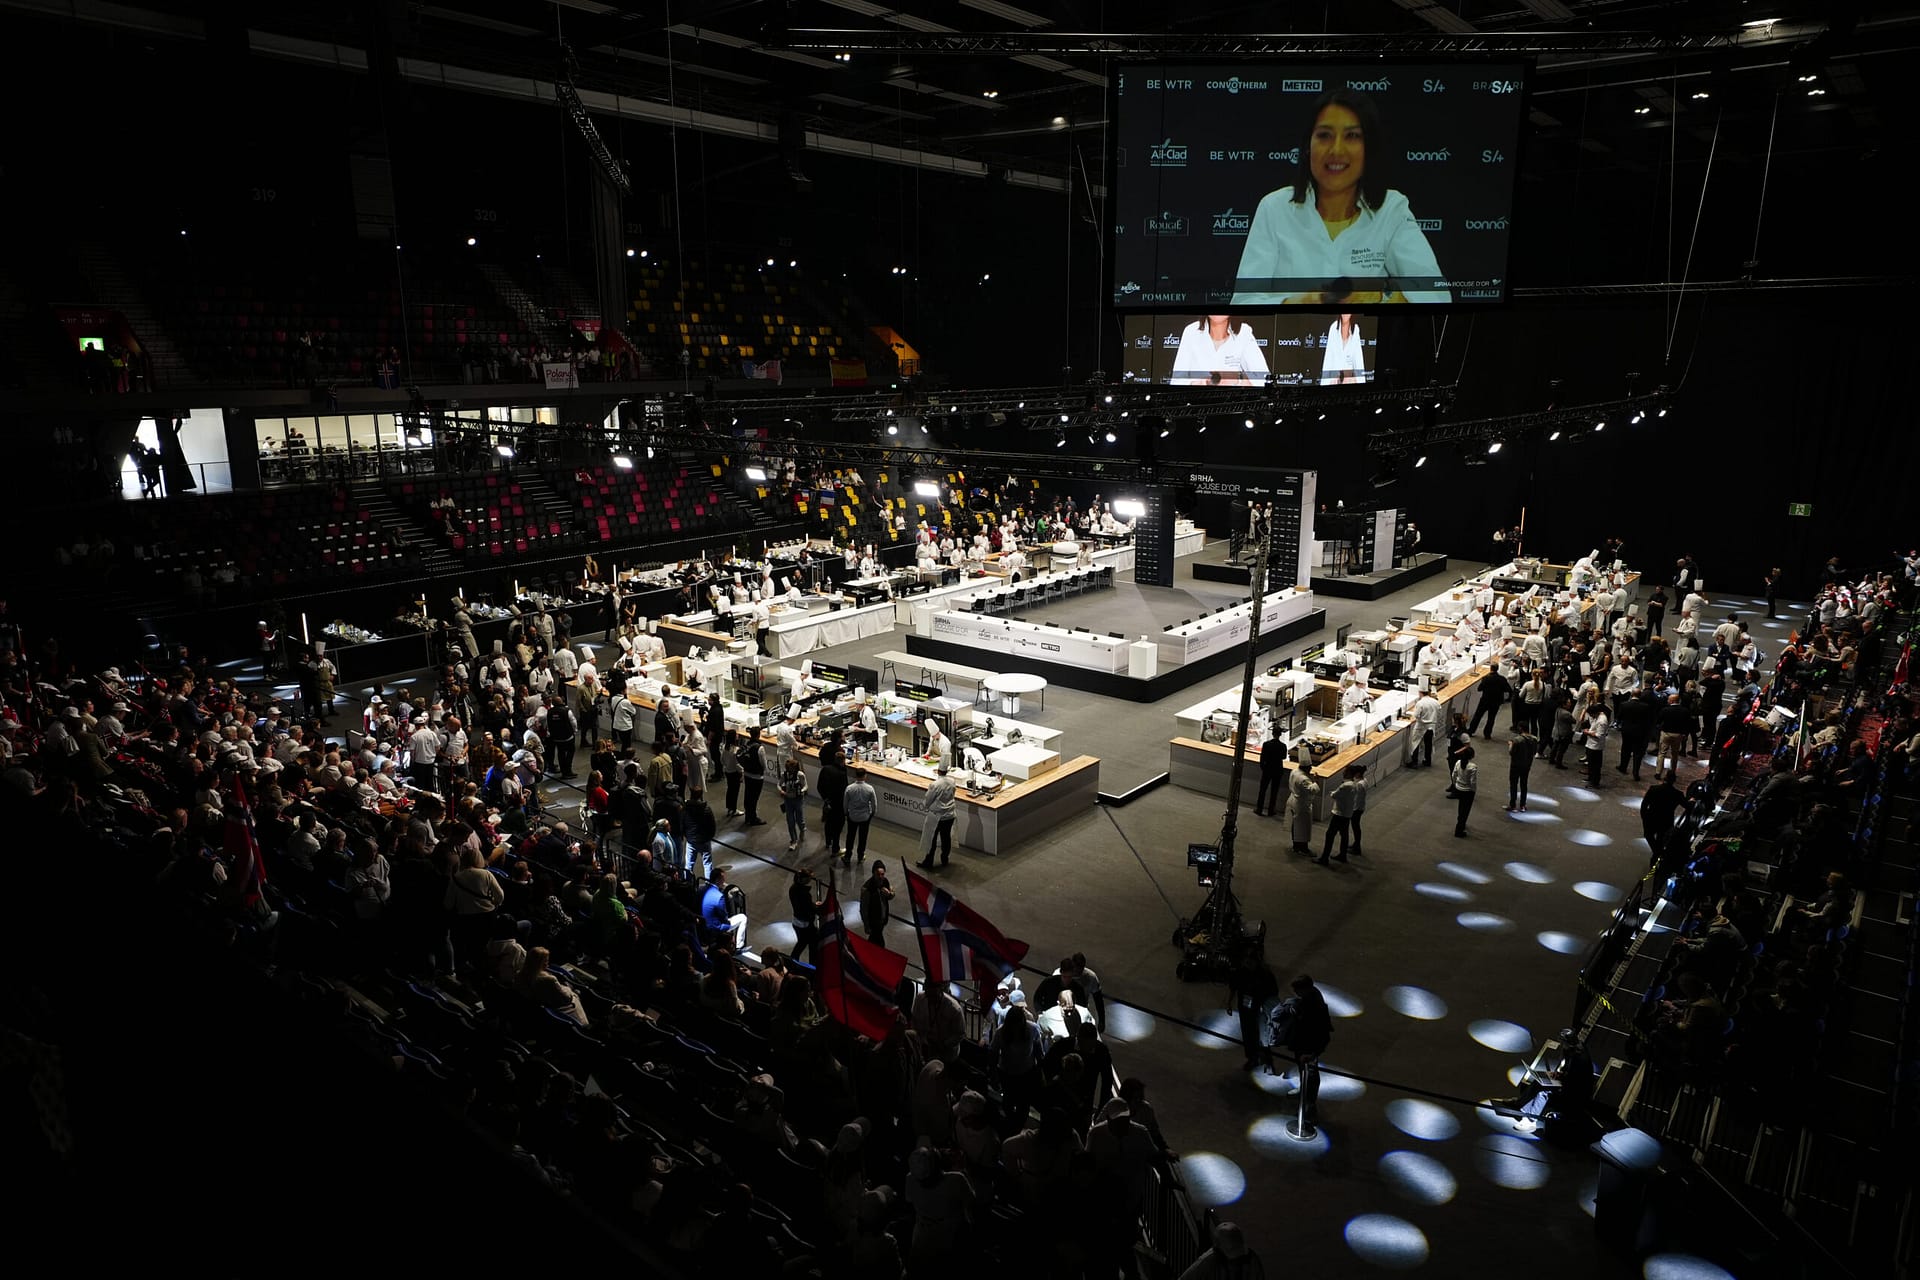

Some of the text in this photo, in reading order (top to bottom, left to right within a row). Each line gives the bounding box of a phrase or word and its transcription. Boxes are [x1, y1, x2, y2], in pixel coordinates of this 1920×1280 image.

[1146, 80, 1192, 89] BE WTR
[1206, 77, 1267, 94] CONVOTHERM
[1283, 80, 1322, 91] METRO
[1151, 149, 1187, 160] All-Clad
[1210, 151, 1255, 160] BE WTR
[1142, 293, 1186, 301] POMMERY
